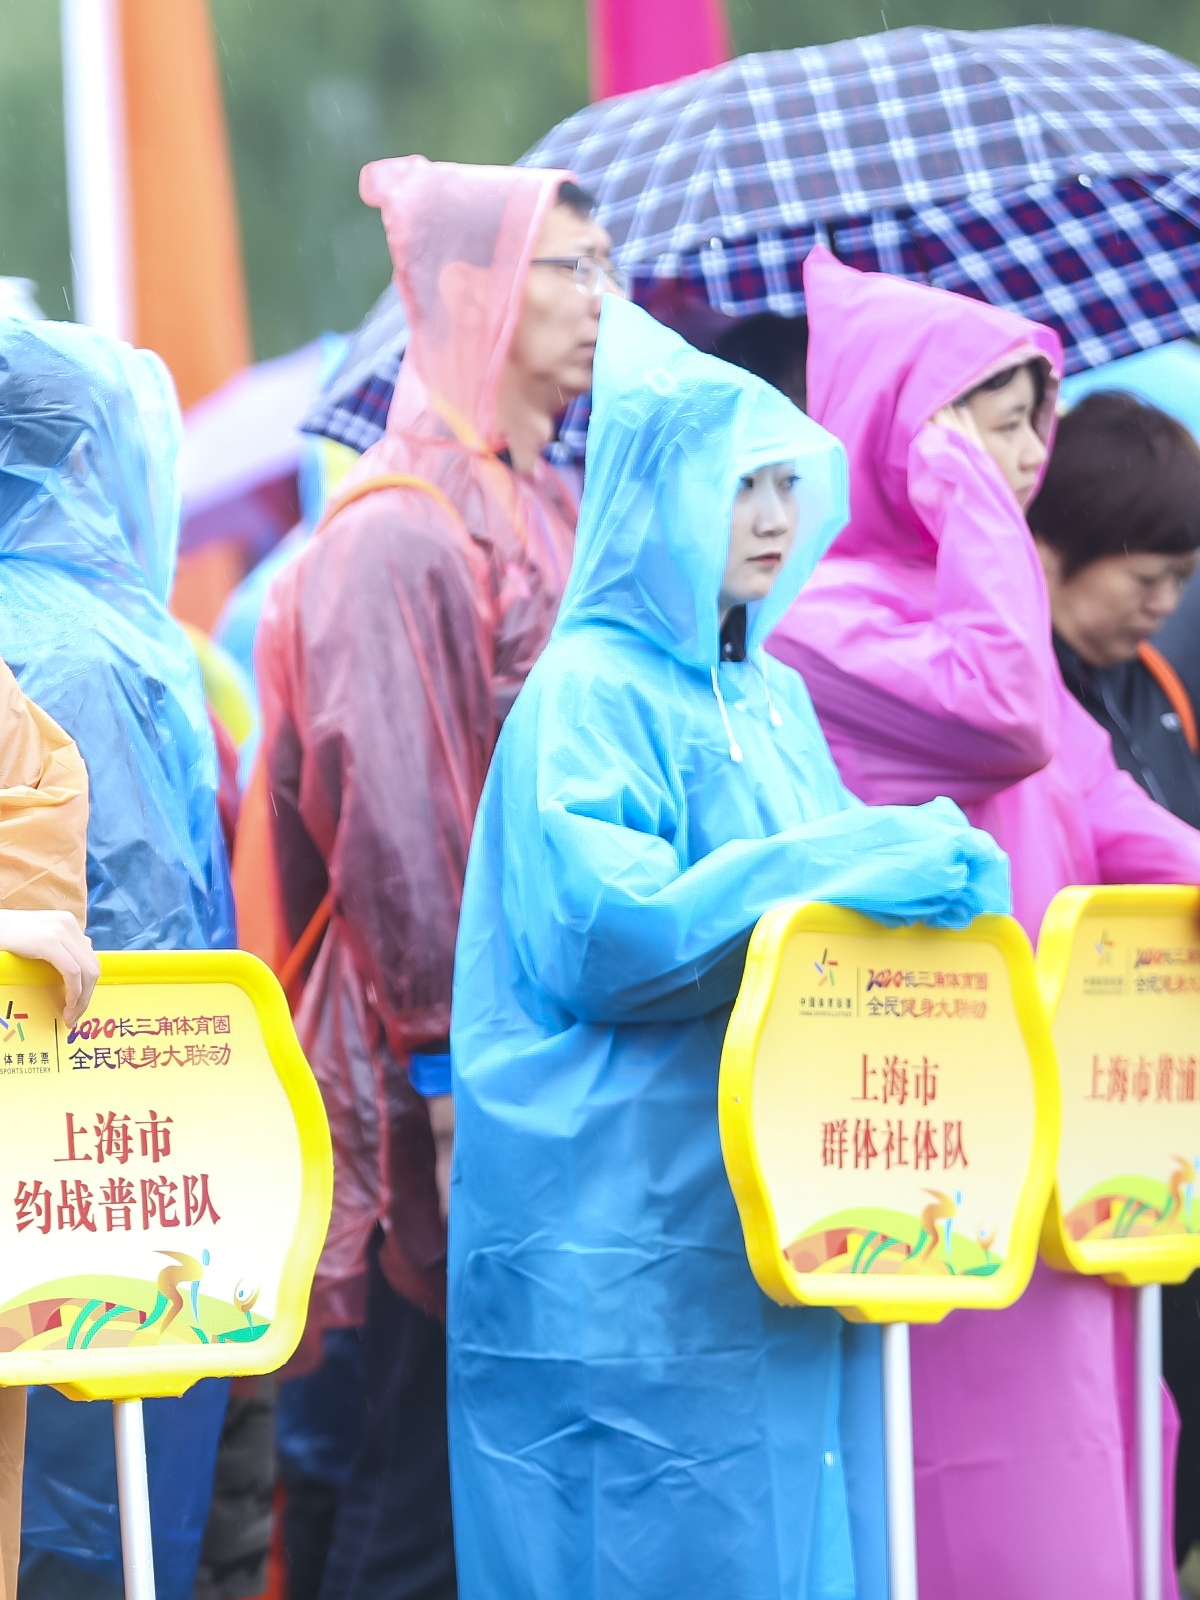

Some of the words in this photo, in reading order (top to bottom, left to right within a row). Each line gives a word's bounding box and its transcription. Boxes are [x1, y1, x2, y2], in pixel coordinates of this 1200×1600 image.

[67, 1015, 231, 1044] 2020长三角体育圈
[0, 1067, 23, 1075] SPORTS
[24, 1066, 51, 1074] LOTTERY
[68, 1043, 232, 1070] 全民健身大联动
[850, 1053, 940, 1107] 上海市
[1085, 1054, 1200, 1103] 上海市黄浦
[53, 1110, 174, 1165] 上海市
[820, 1117, 969, 1171] 群体社体队
[13, 1173, 222, 1235] 约战普陀队
